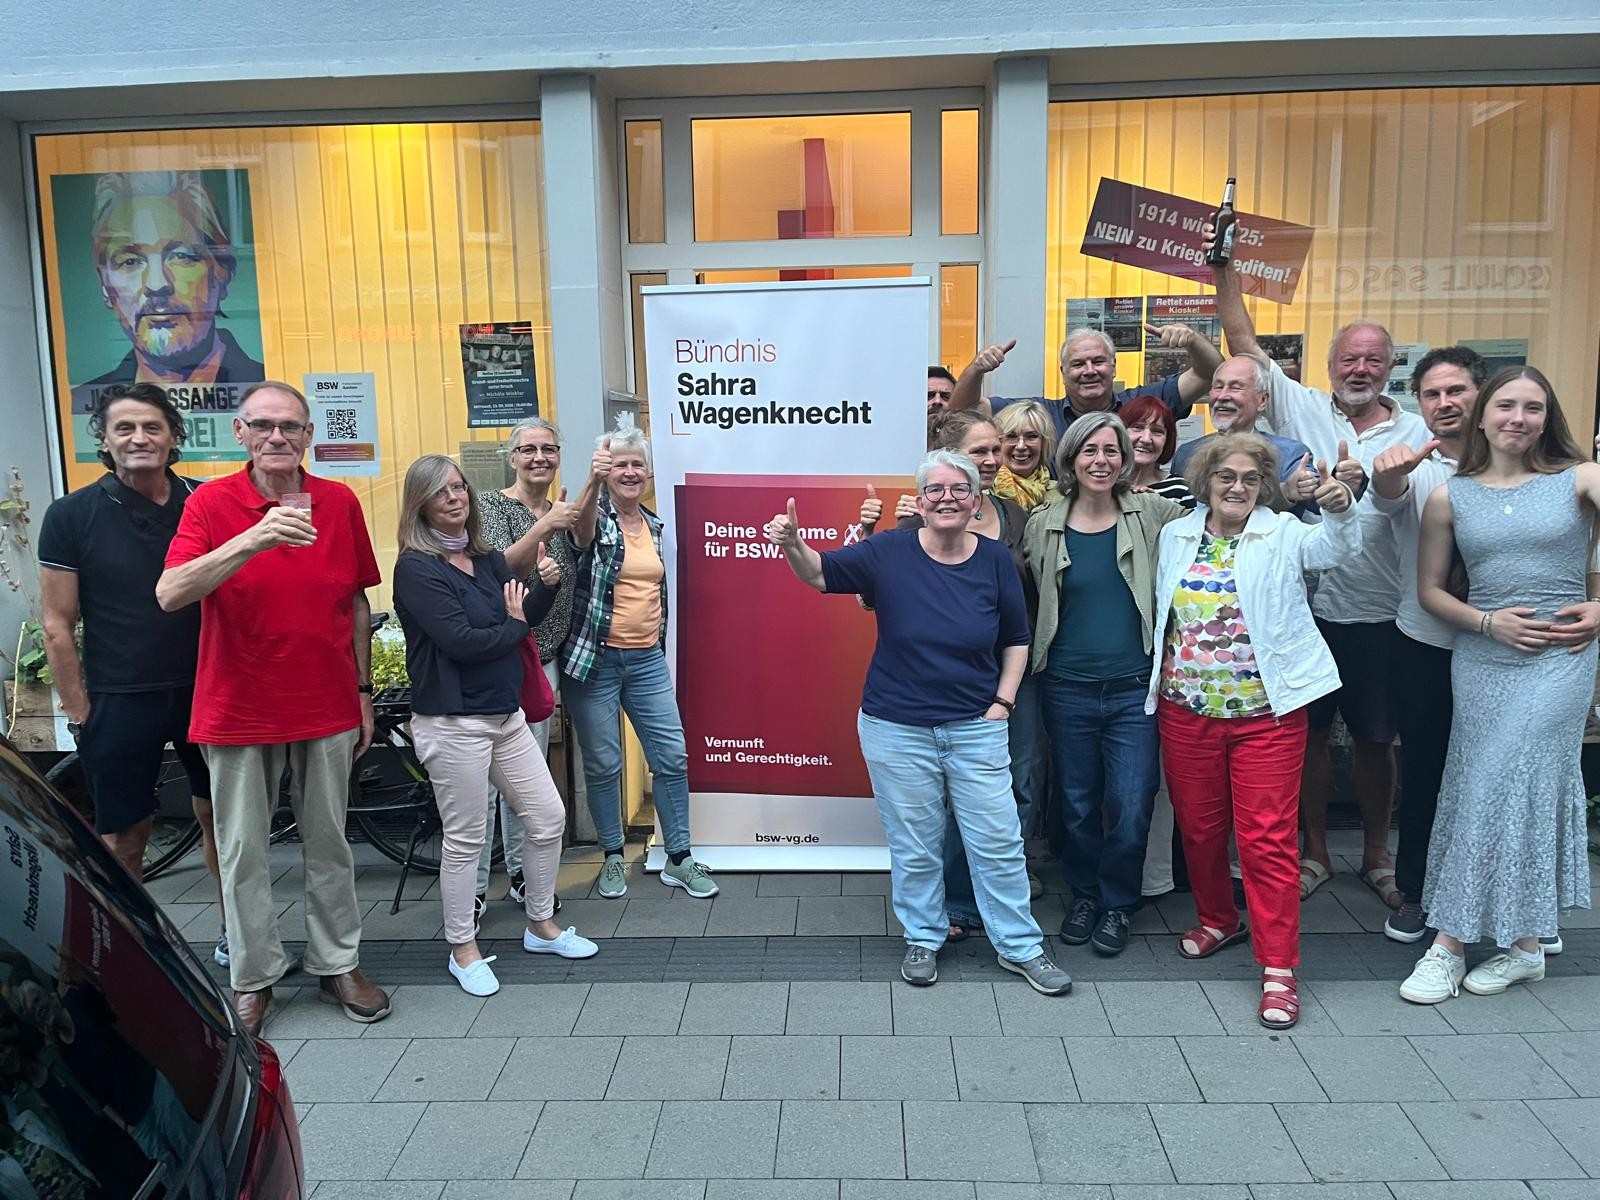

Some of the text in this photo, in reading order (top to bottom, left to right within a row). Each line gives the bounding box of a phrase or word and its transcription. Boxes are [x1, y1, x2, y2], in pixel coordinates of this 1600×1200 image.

[1137, 202, 1178, 226] 1914
[1092, 221, 1135, 245] NEIN
[1136, 235, 1157, 252] zu
[1160, 240, 1292, 284] Kriegediten!
[1155, 298, 1182, 306] Rettet
[1168, 306, 1200, 314] Kioske!
[675, 338, 777, 363] Bündnis
[316, 381, 339, 390] BSW
[677, 372, 756, 396] Sahra
[167, 386, 239, 411] SSANGE
[678, 400, 872, 430] Wagenknecht
[183, 417, 216, 448] REI
[704, 521, 838, 540] Deine Sme
[704, 542, 784, 559] für BSW.
[704, 736, 765, 749] Vernunft
[705, 751, 833, 767] und Gerechtigkeit.
[755, 832, 820, 845] bsw-vg.de
